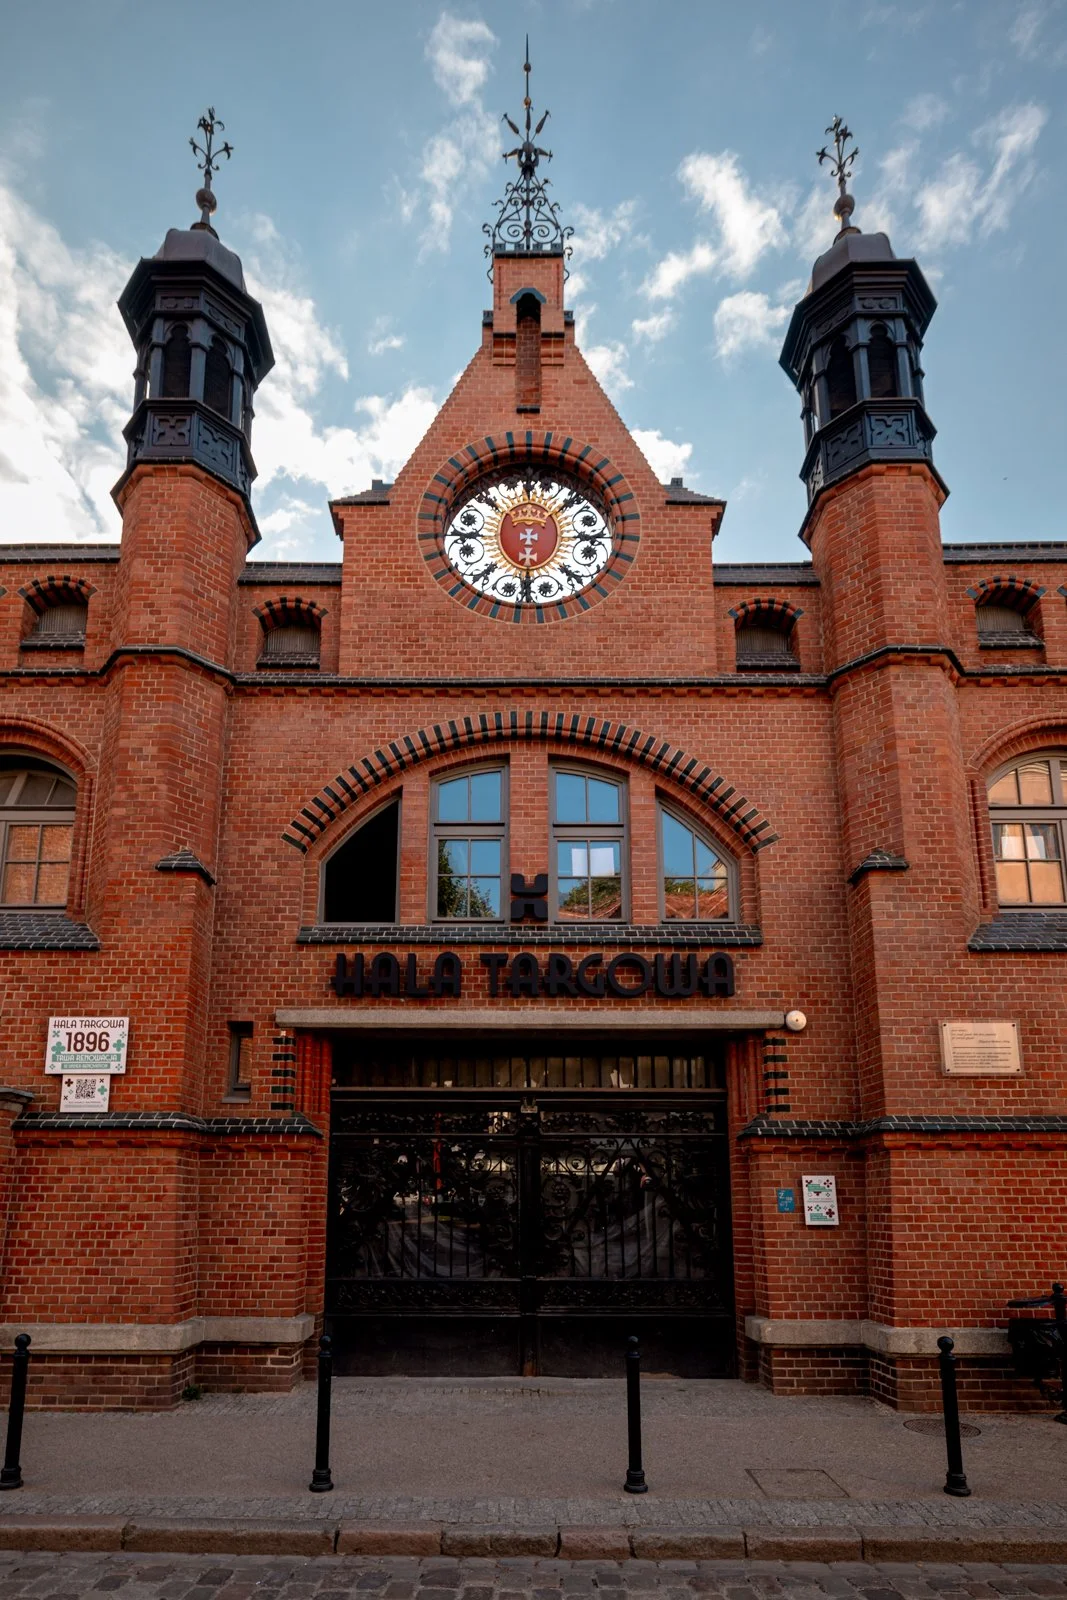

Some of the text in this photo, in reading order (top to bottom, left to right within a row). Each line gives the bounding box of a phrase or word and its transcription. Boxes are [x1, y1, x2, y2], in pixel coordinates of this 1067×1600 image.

[331, 951, 735, 997] HALA TARGOWA
[54, 1020, 125, 1029] HALA TARGOWA
[65, 1031, 110, 1052] 1896
